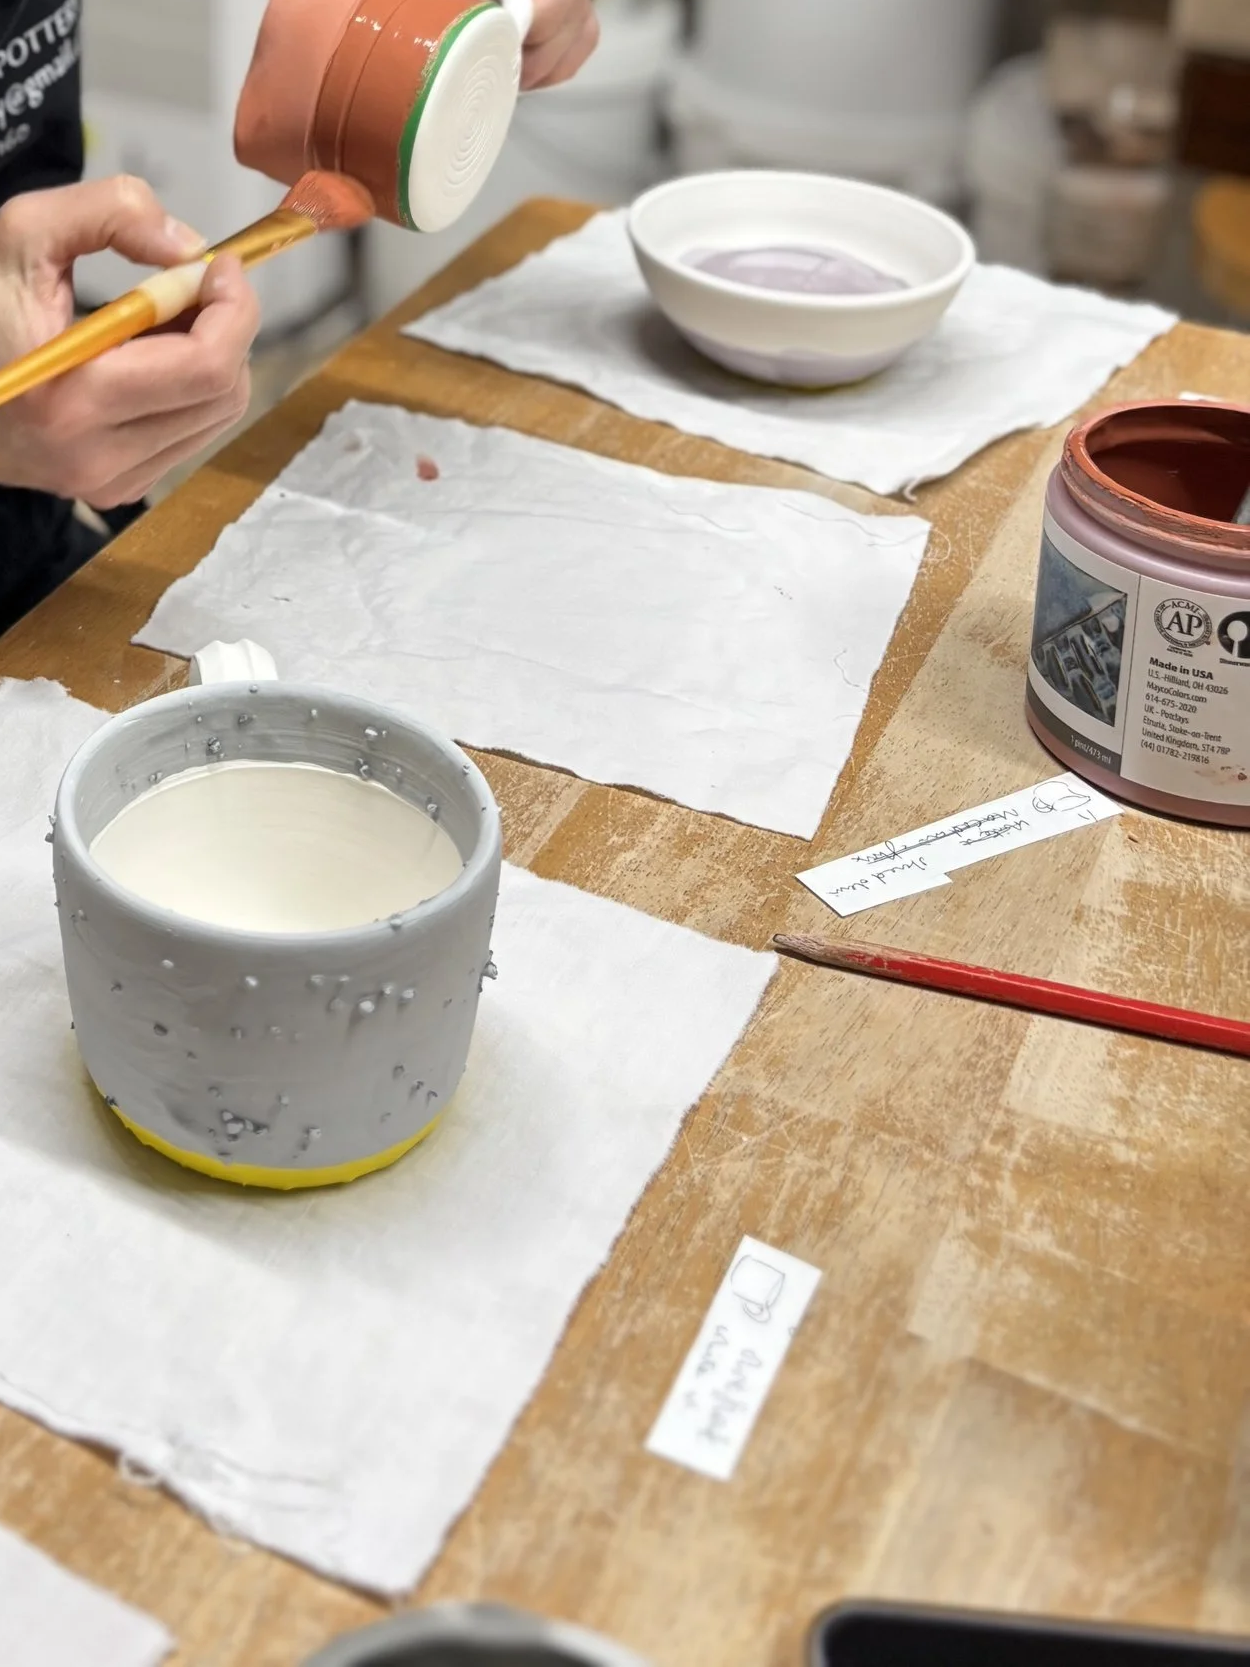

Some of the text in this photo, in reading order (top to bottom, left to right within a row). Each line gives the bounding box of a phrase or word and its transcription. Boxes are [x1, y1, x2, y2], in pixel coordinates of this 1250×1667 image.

[1171, 600, 1200, 614] ACMI
[1164, 610, 1203, 637] AP
[1149, 656, 1214, 680] Made in USA
[1146, 680, 1207, 704] MaycoColors.com
[1192, 680, 1204, 691] OH
[1205, 683, 1229, 695] 43026
[1144, 703, 1154, 714] UK
[1145, 692, 1197, 714] 614-675-2020
[1141, 727, 1165, 742] United
[1140, 739, 1155, 752] (44)
[1101, 754, 1112, 764] ml
